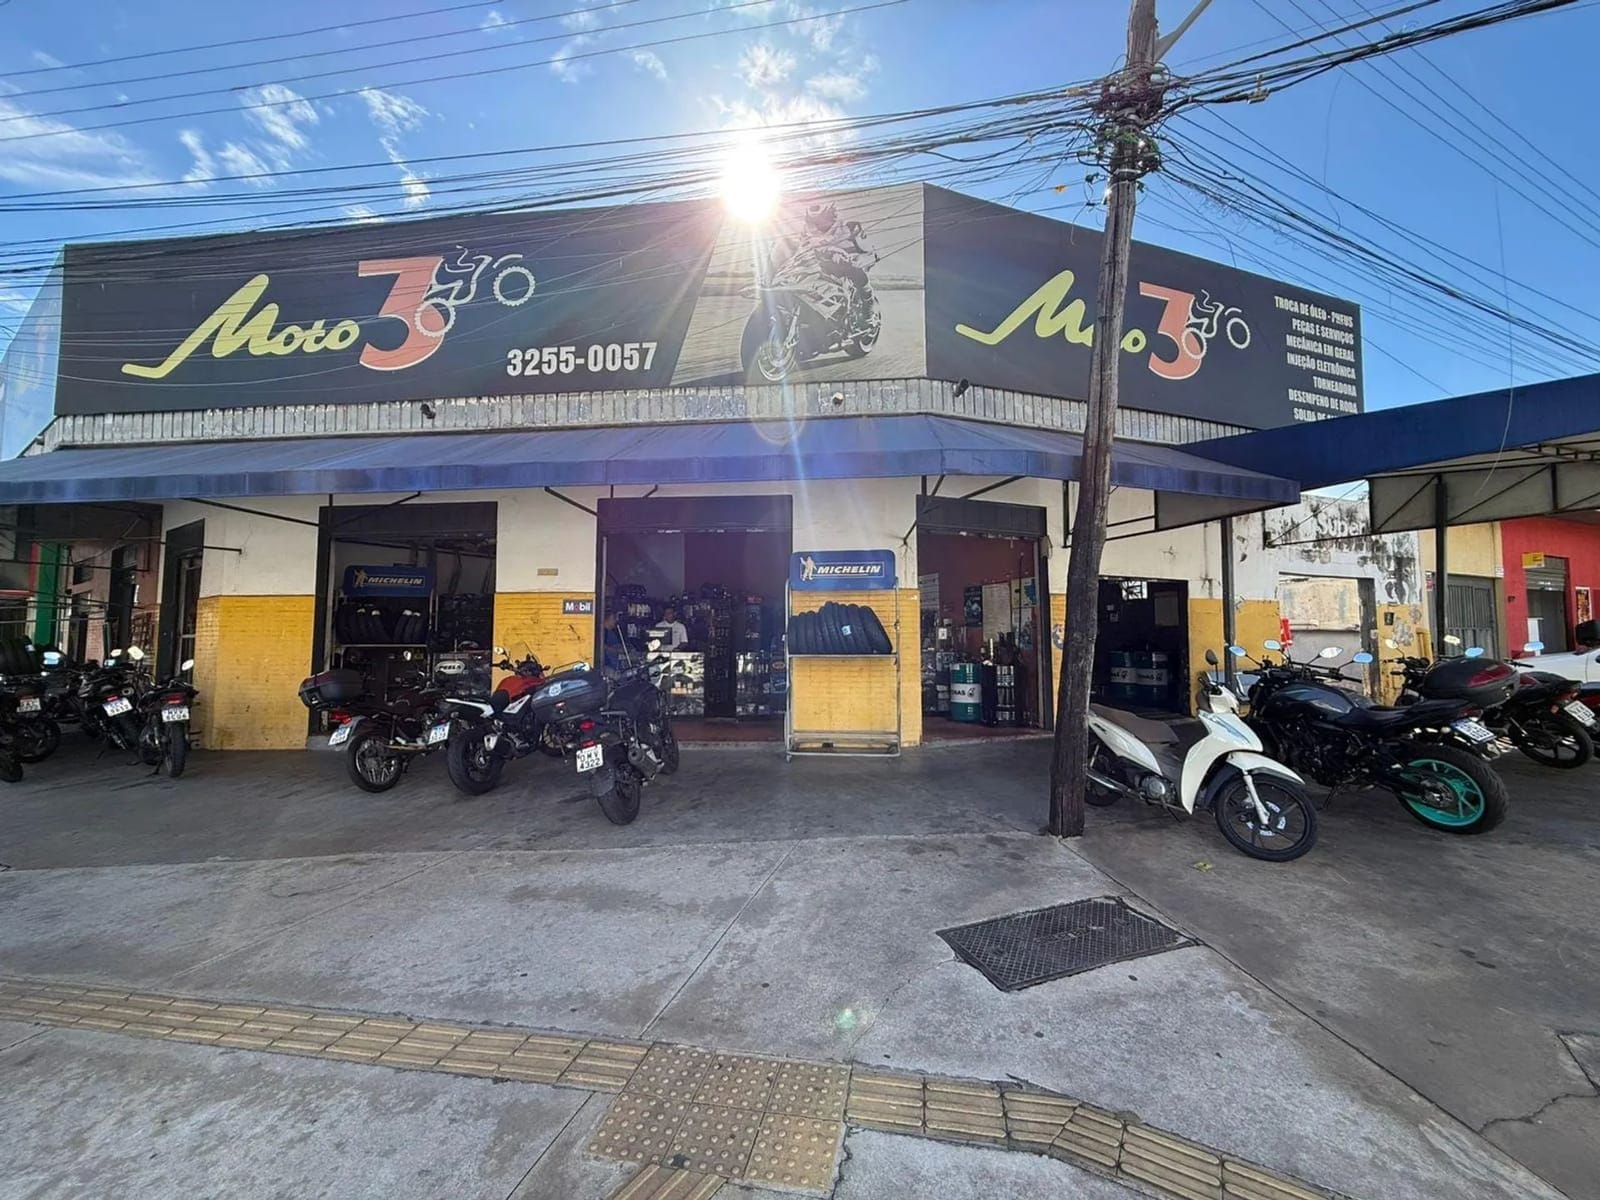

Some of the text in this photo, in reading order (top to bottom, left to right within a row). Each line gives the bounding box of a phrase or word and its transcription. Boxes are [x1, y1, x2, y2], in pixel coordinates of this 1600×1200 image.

[1274, 296, 1299, 313] TROCA
[1299, 302, 1310, 316] DE
[1309, 302, 1327, 320] ÓLEO
[121, 273, 360, 379] Moto
[1292, 318, 1354, 345] PEÇAS E SERVIÇOS
[506, 341, 658, 377] 3255-0057
[1286, 334, 1355, 362] MECÂNICA EM GERAL
[1287, 352, 1356, 379] INJEÇÃO ELETRÔNICA
[1312, 376, 1357, 397] TORNEADORA
[1288, 389, 1330, 408] DESEMPENO
[1330, 398, 1339, 410] DE
[1293, 407, 1316, 422] SOLDA
[818, 565, 881, 574] MICHELIN
[368, 577, 423, 585] MICHELIN
[565, 601, 591, 611] Mobil
